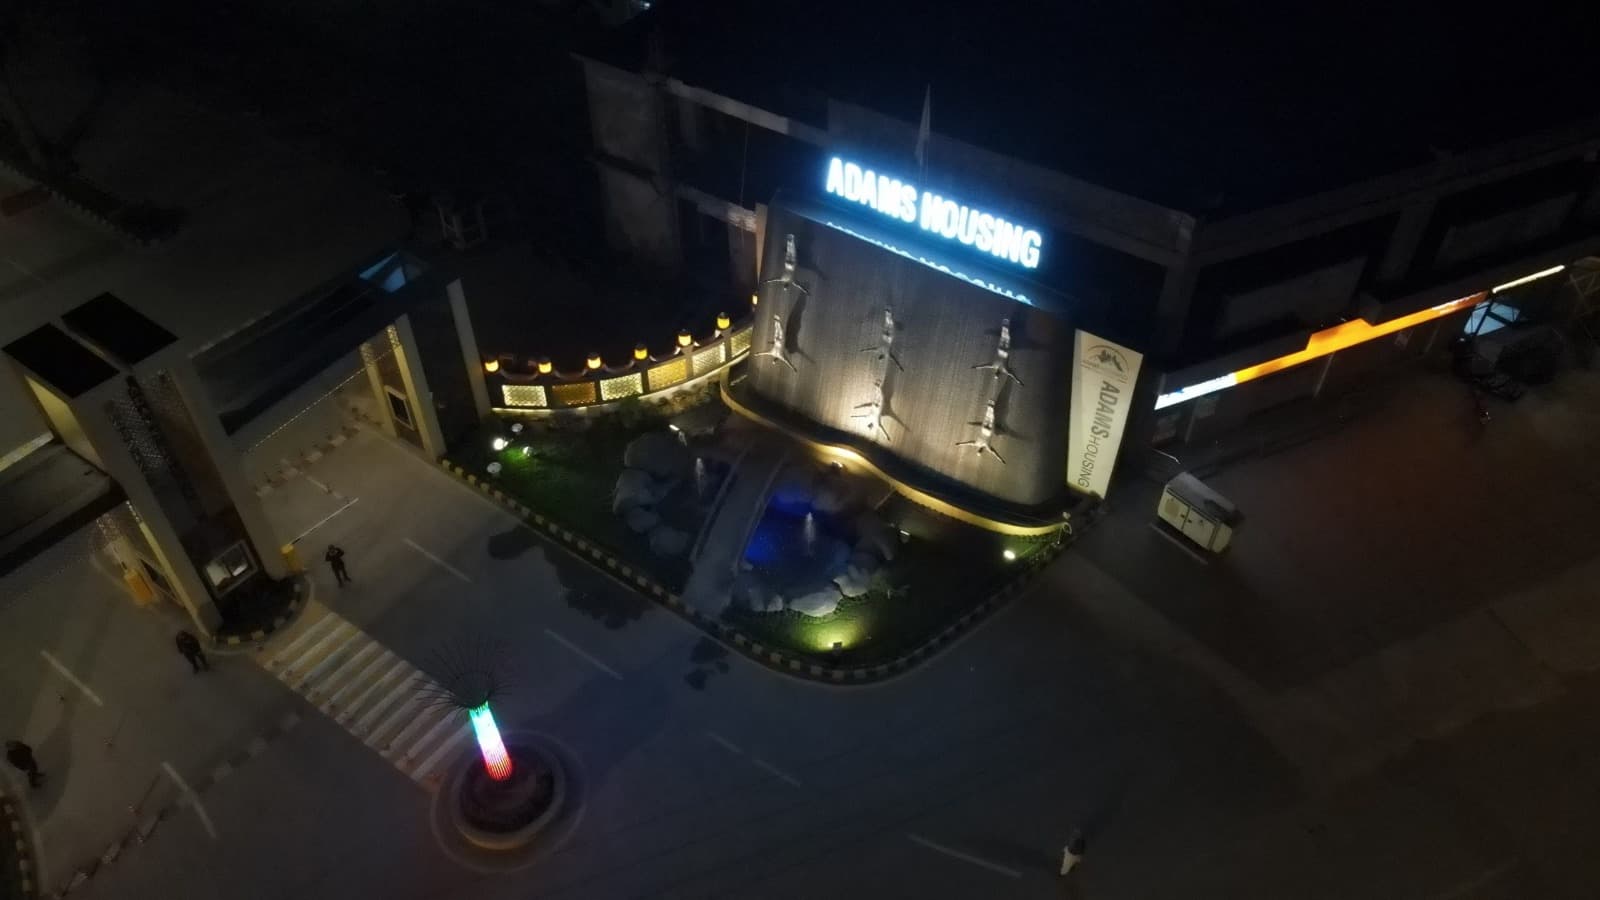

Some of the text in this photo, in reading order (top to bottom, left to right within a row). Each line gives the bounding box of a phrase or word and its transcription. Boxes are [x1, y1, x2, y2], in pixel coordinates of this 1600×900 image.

[826, 157, 917, 223] ADAMS
[920, 191, 1042, 269] HOUSING
[1091, 380, 1120, 439] ADAMS
